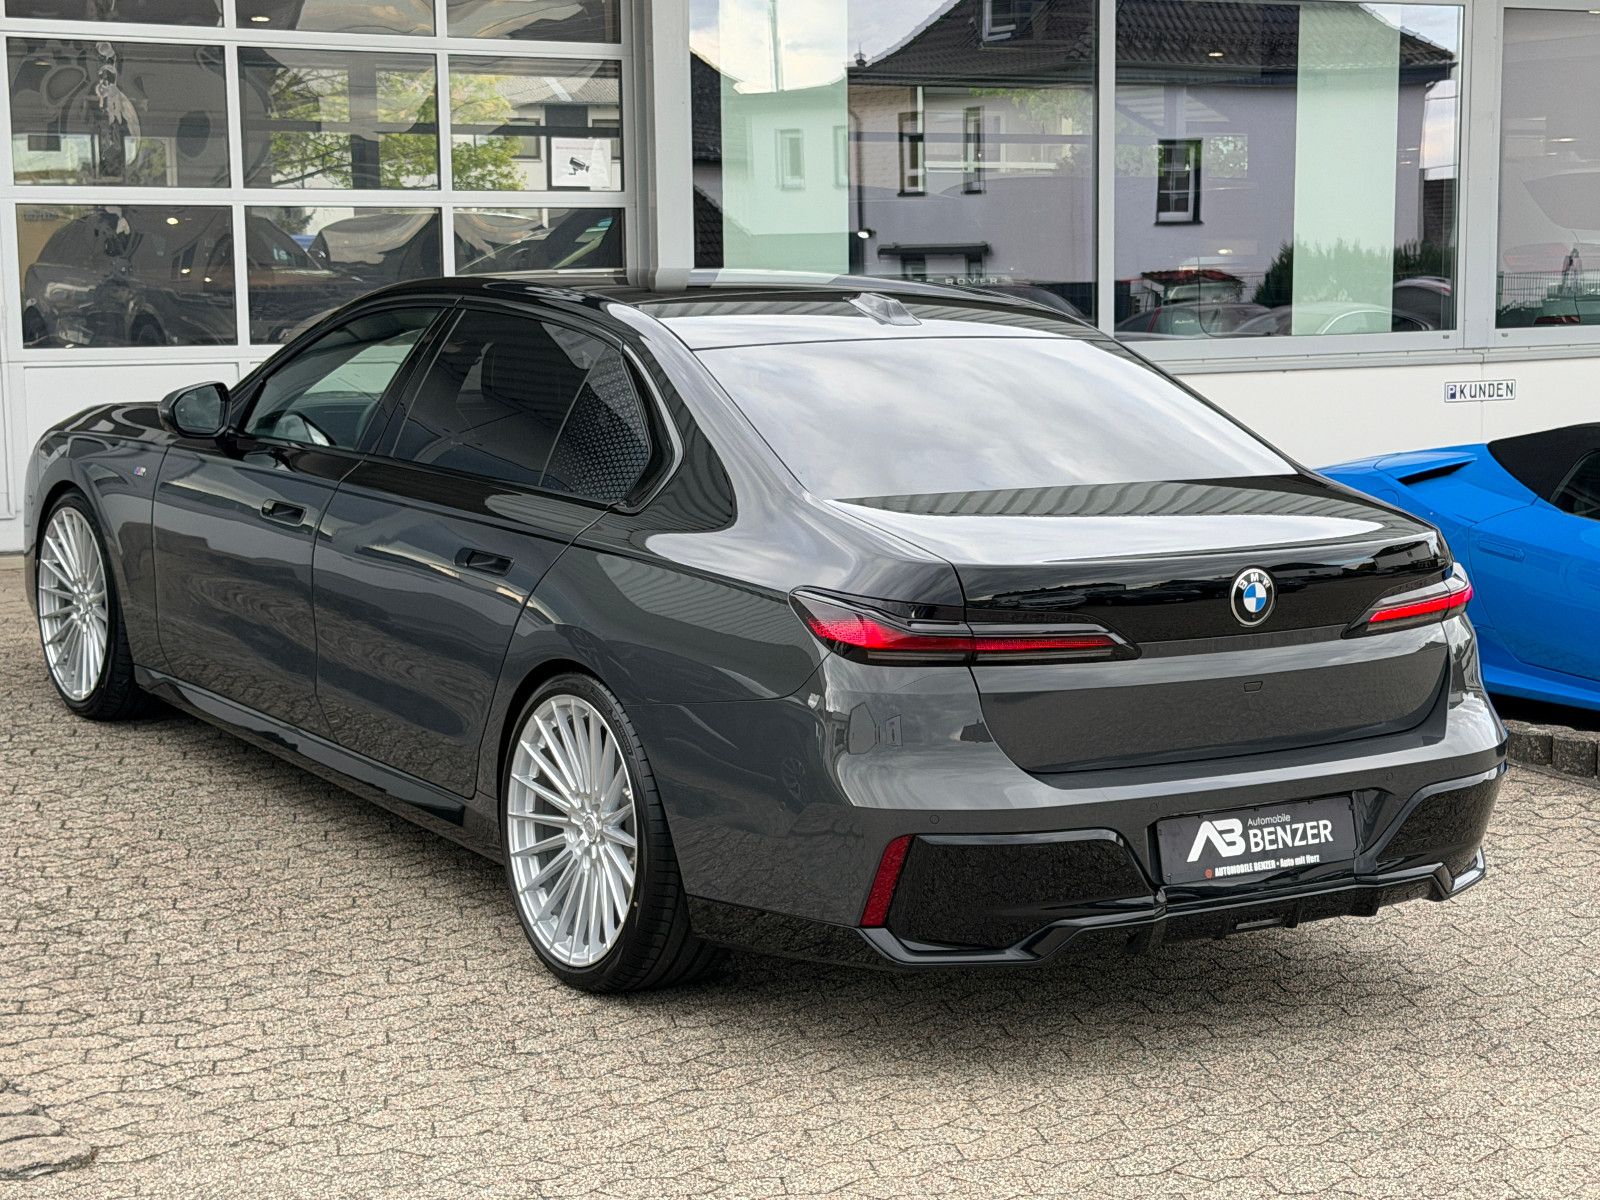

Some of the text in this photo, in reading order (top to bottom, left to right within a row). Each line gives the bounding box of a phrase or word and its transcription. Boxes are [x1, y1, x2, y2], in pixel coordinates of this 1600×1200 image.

[945, 276, 999, 286] ROVER
[1447, 382, 1514, 399] P KUNDEN
[1238, 572, 1271, 591] BMW
[1247, 813, 1291, 827] Automobile
[1249, 819, 1334, 853] BENZER
[1214, 862, 1253, 877] AUTOMOBILE
[1253, 859, 1276, 872] BENZER
